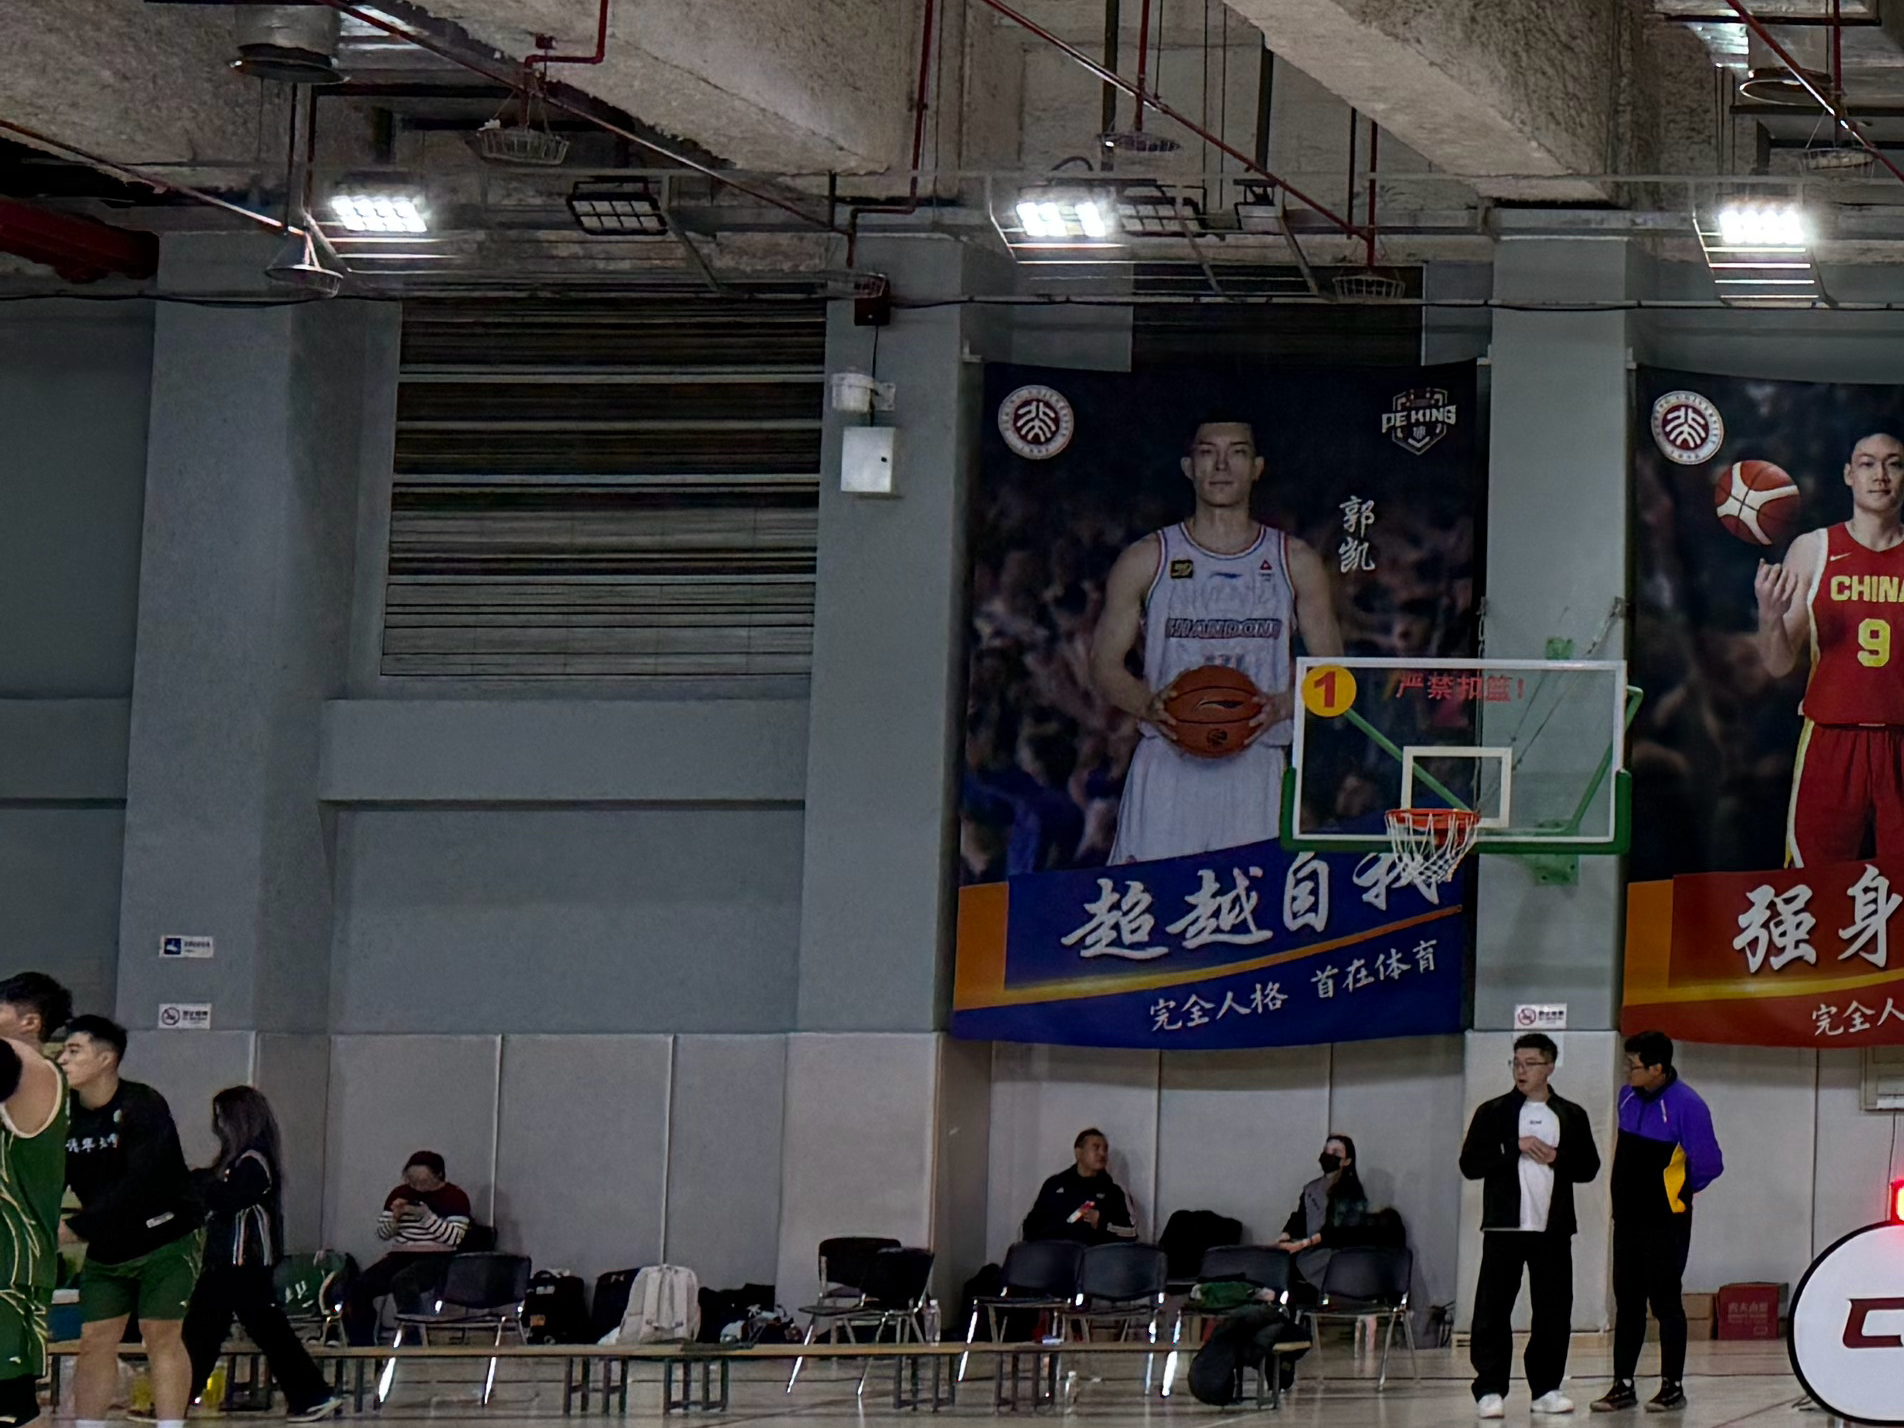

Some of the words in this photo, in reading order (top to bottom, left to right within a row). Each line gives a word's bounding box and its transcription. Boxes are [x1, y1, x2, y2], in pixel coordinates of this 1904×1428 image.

[1338, 495, 1376, 573] 郭凯
[1857, 618, 1891, 668] 9
[1314, 670, 1337, 709] 1
[1149, 983, 1289, 1032] 完全人格
[1310, 939, 1438, 1000] 首在体育
